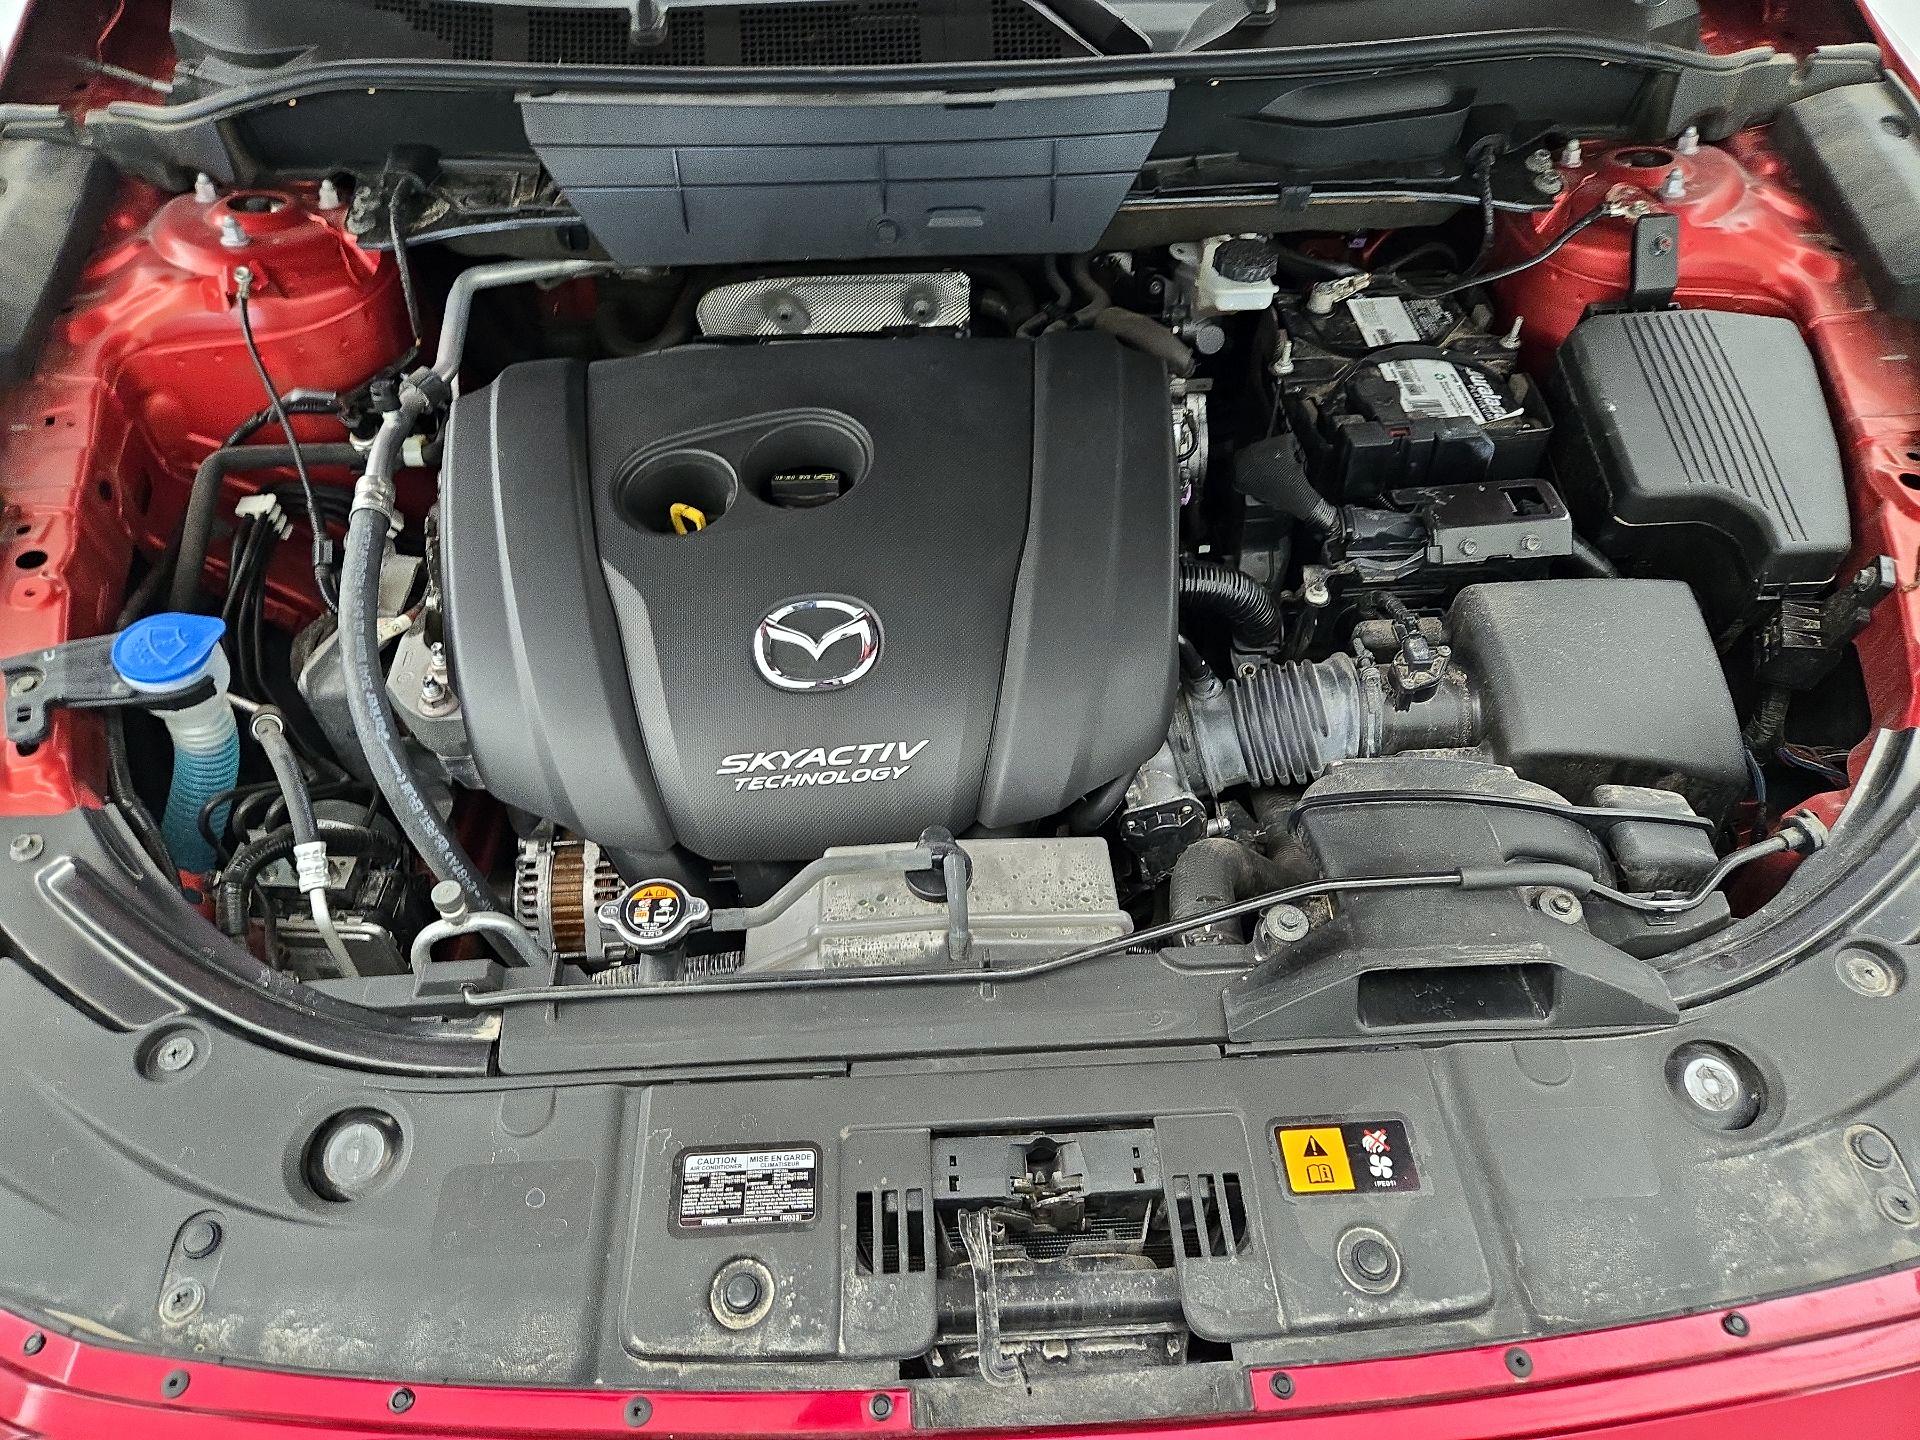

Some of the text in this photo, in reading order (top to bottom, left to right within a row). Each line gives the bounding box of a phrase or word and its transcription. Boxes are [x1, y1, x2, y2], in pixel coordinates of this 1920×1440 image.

[716, 739, 930, 775] SKYACTIV
[734, 765, 911, 792] TECHNOLOGY
[697, 1156, 737, 1165] CAUTION
[749, 1153, 812, 1163] MISE EN GARDE
